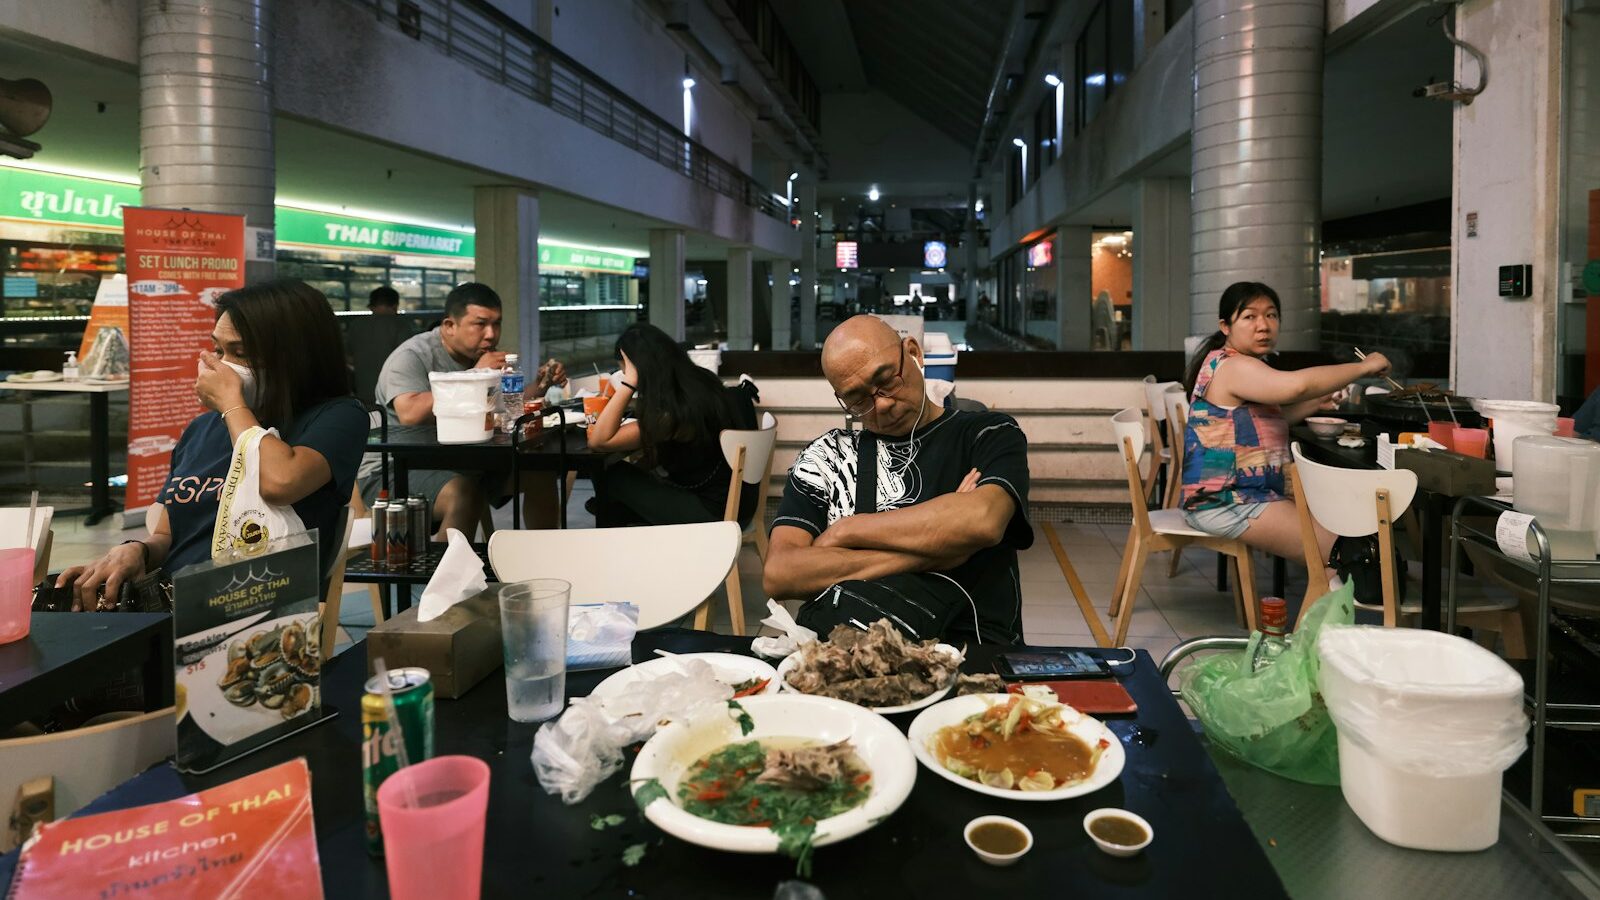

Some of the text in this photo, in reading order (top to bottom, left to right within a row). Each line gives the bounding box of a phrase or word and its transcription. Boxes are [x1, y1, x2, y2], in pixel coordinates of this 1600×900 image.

[136, 228, 227, 240] HOUSE OF THAI
[325, 223, 463, 252] THAI SUPERMARKET
[139, 255, 238, 271] SET LUNCH PROMO
[183, 271, 200, 279] WITH
[133, 283, 155, 293] 11AM
[163, 284, 180, 293] 3PM
[208, 577, 290, 607] HOUSE OF THAI
[60, 784, 292, 857] HOUSE OF THAI
[128, 832, 238, 868] kitchen
